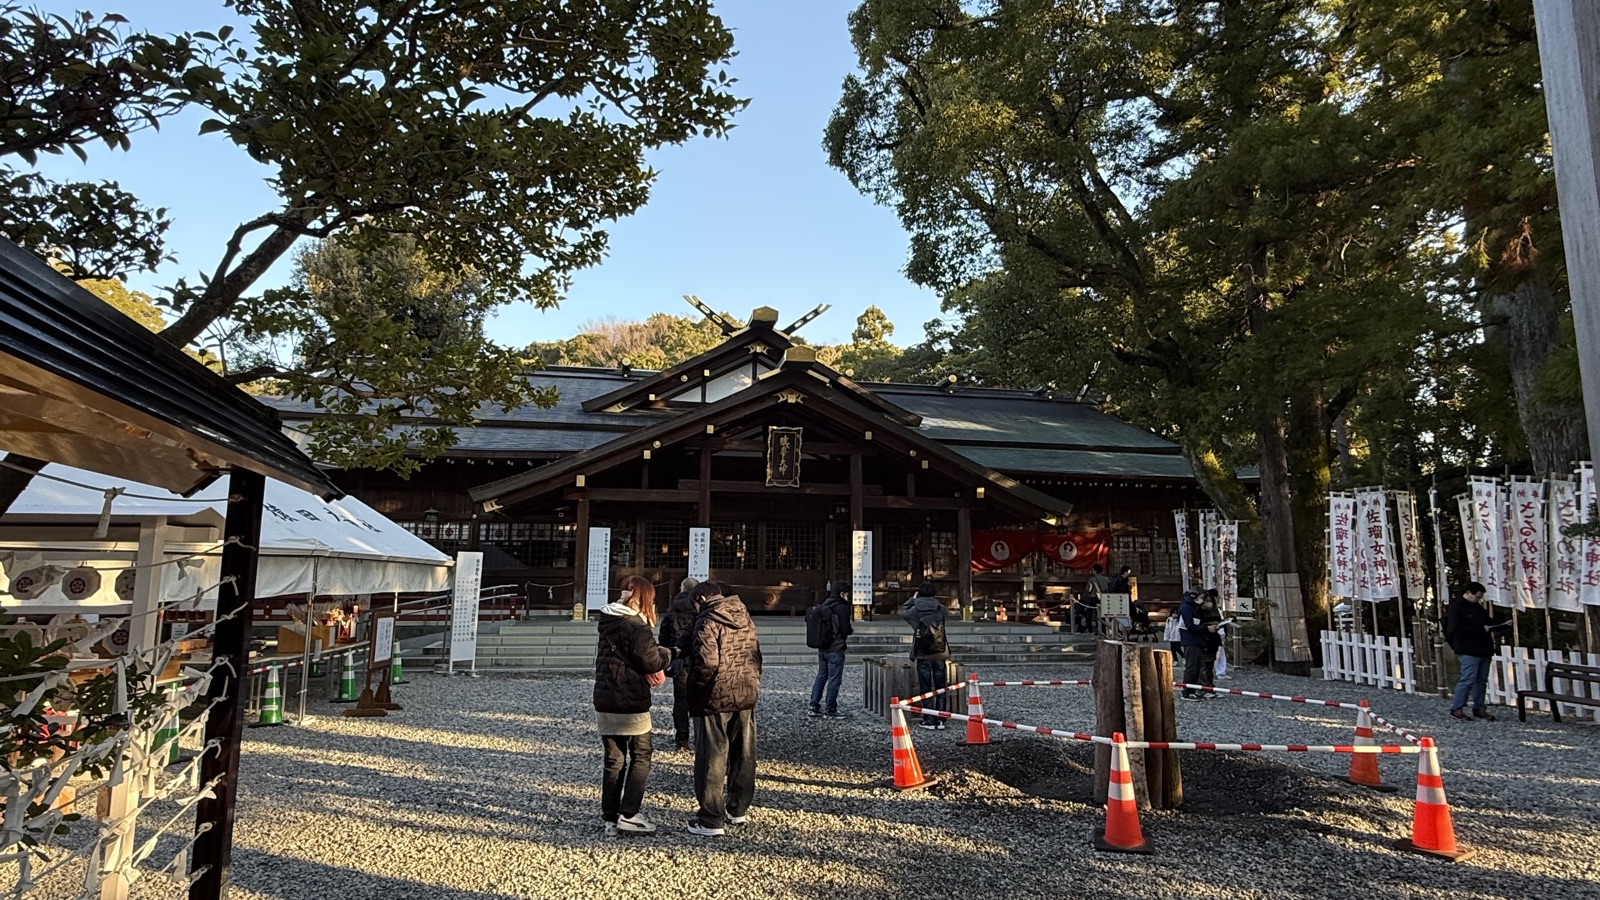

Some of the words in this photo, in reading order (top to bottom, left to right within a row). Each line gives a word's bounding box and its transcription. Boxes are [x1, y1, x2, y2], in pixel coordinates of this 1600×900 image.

[1366, 509, 1392, 588] 佐瑠女神社
